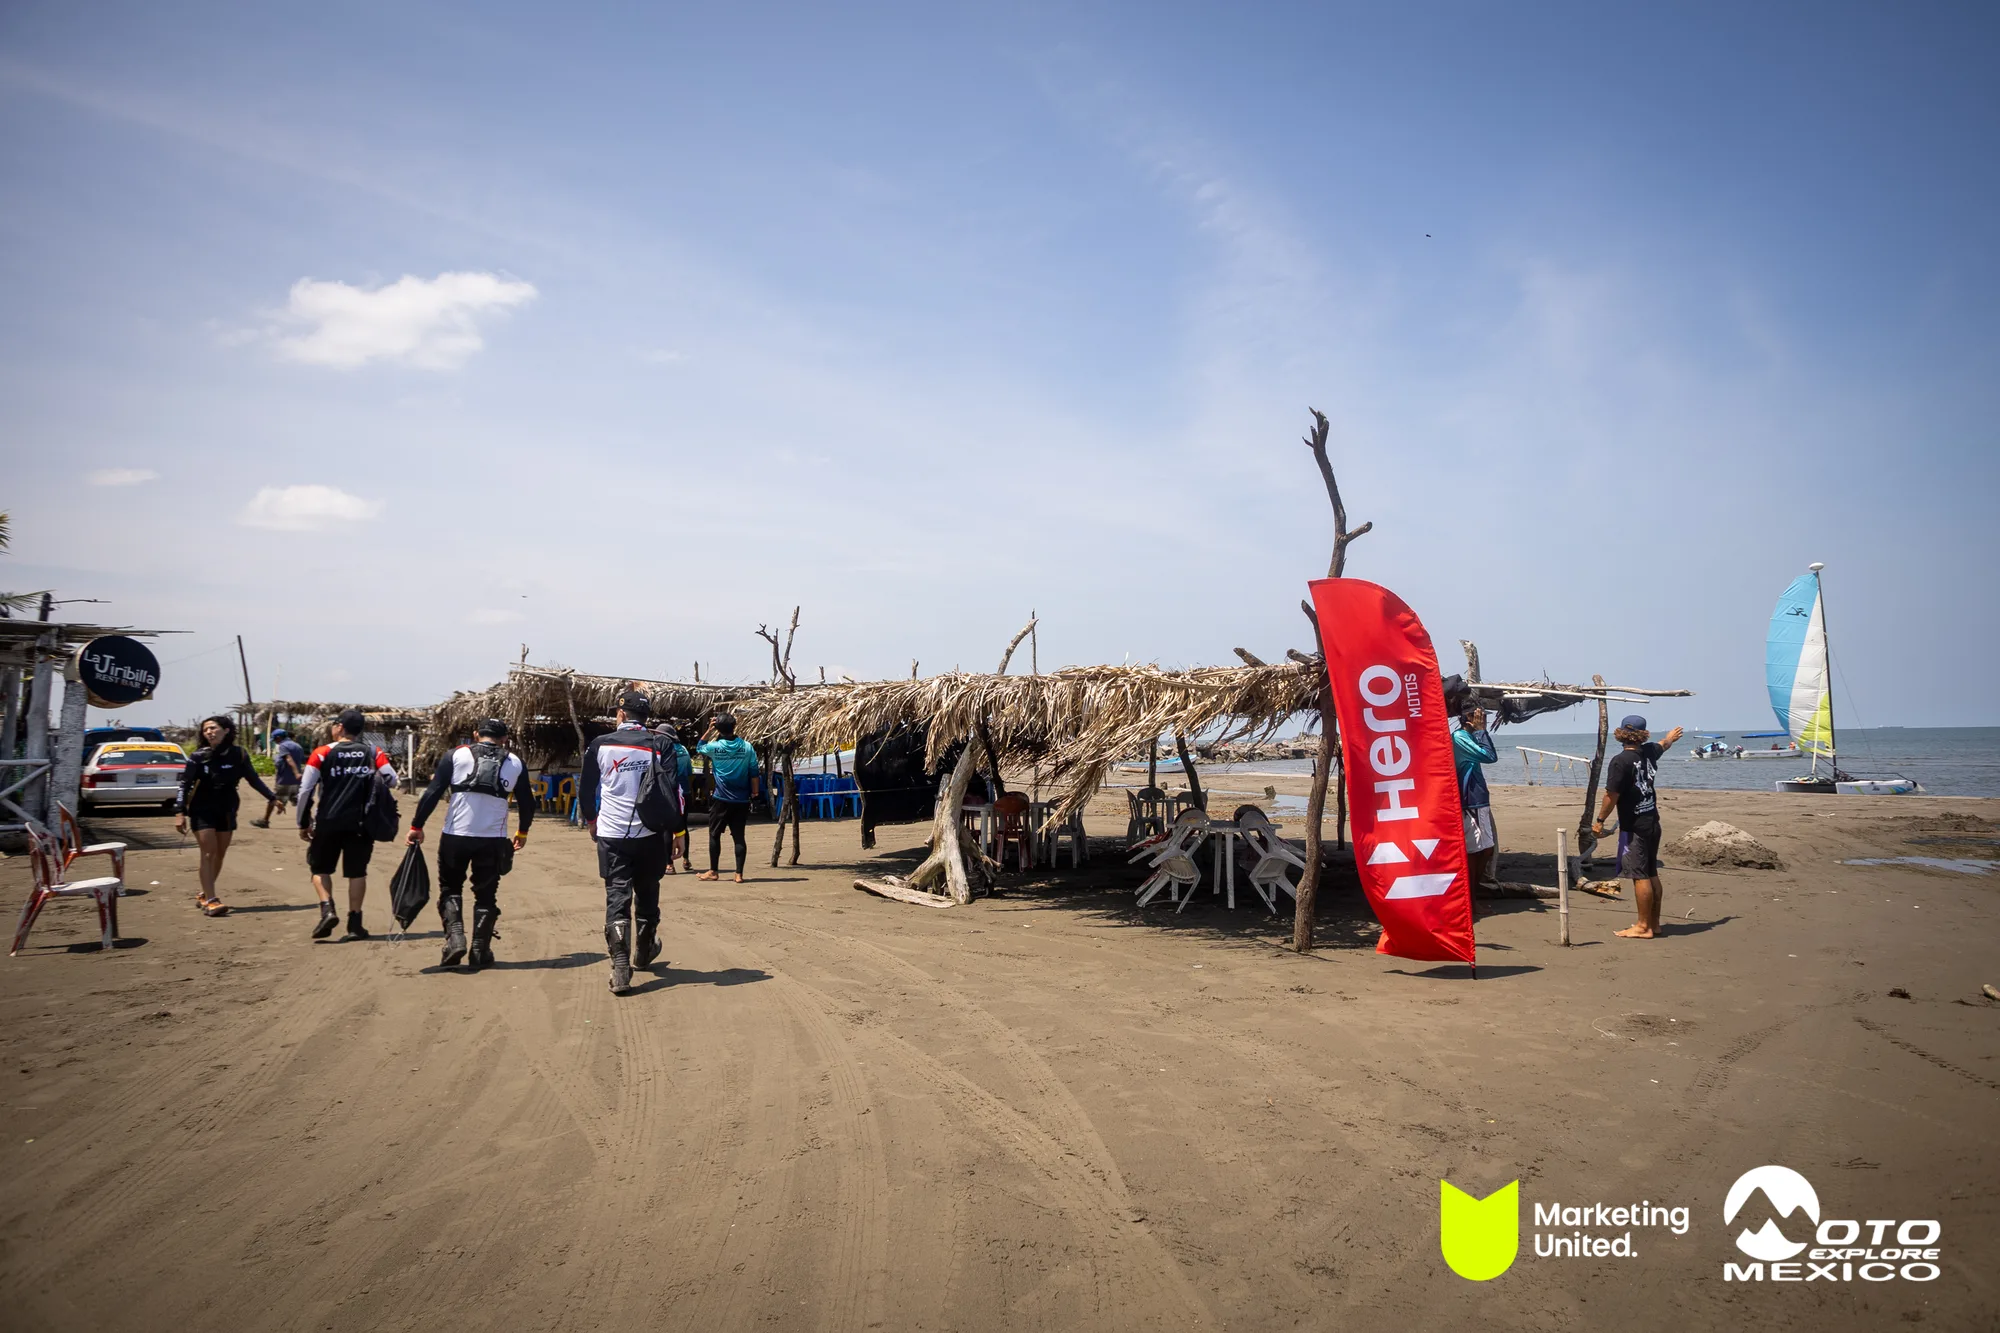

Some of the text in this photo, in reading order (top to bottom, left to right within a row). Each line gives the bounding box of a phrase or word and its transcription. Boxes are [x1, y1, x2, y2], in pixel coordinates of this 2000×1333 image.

[83, 649, 156, 685] La Jiribilla
[95, 672, 141, 688] REST BAR
[1404, 673, 1422, 718] MOTOS
[1358, 664, 1420, 822] Hero
